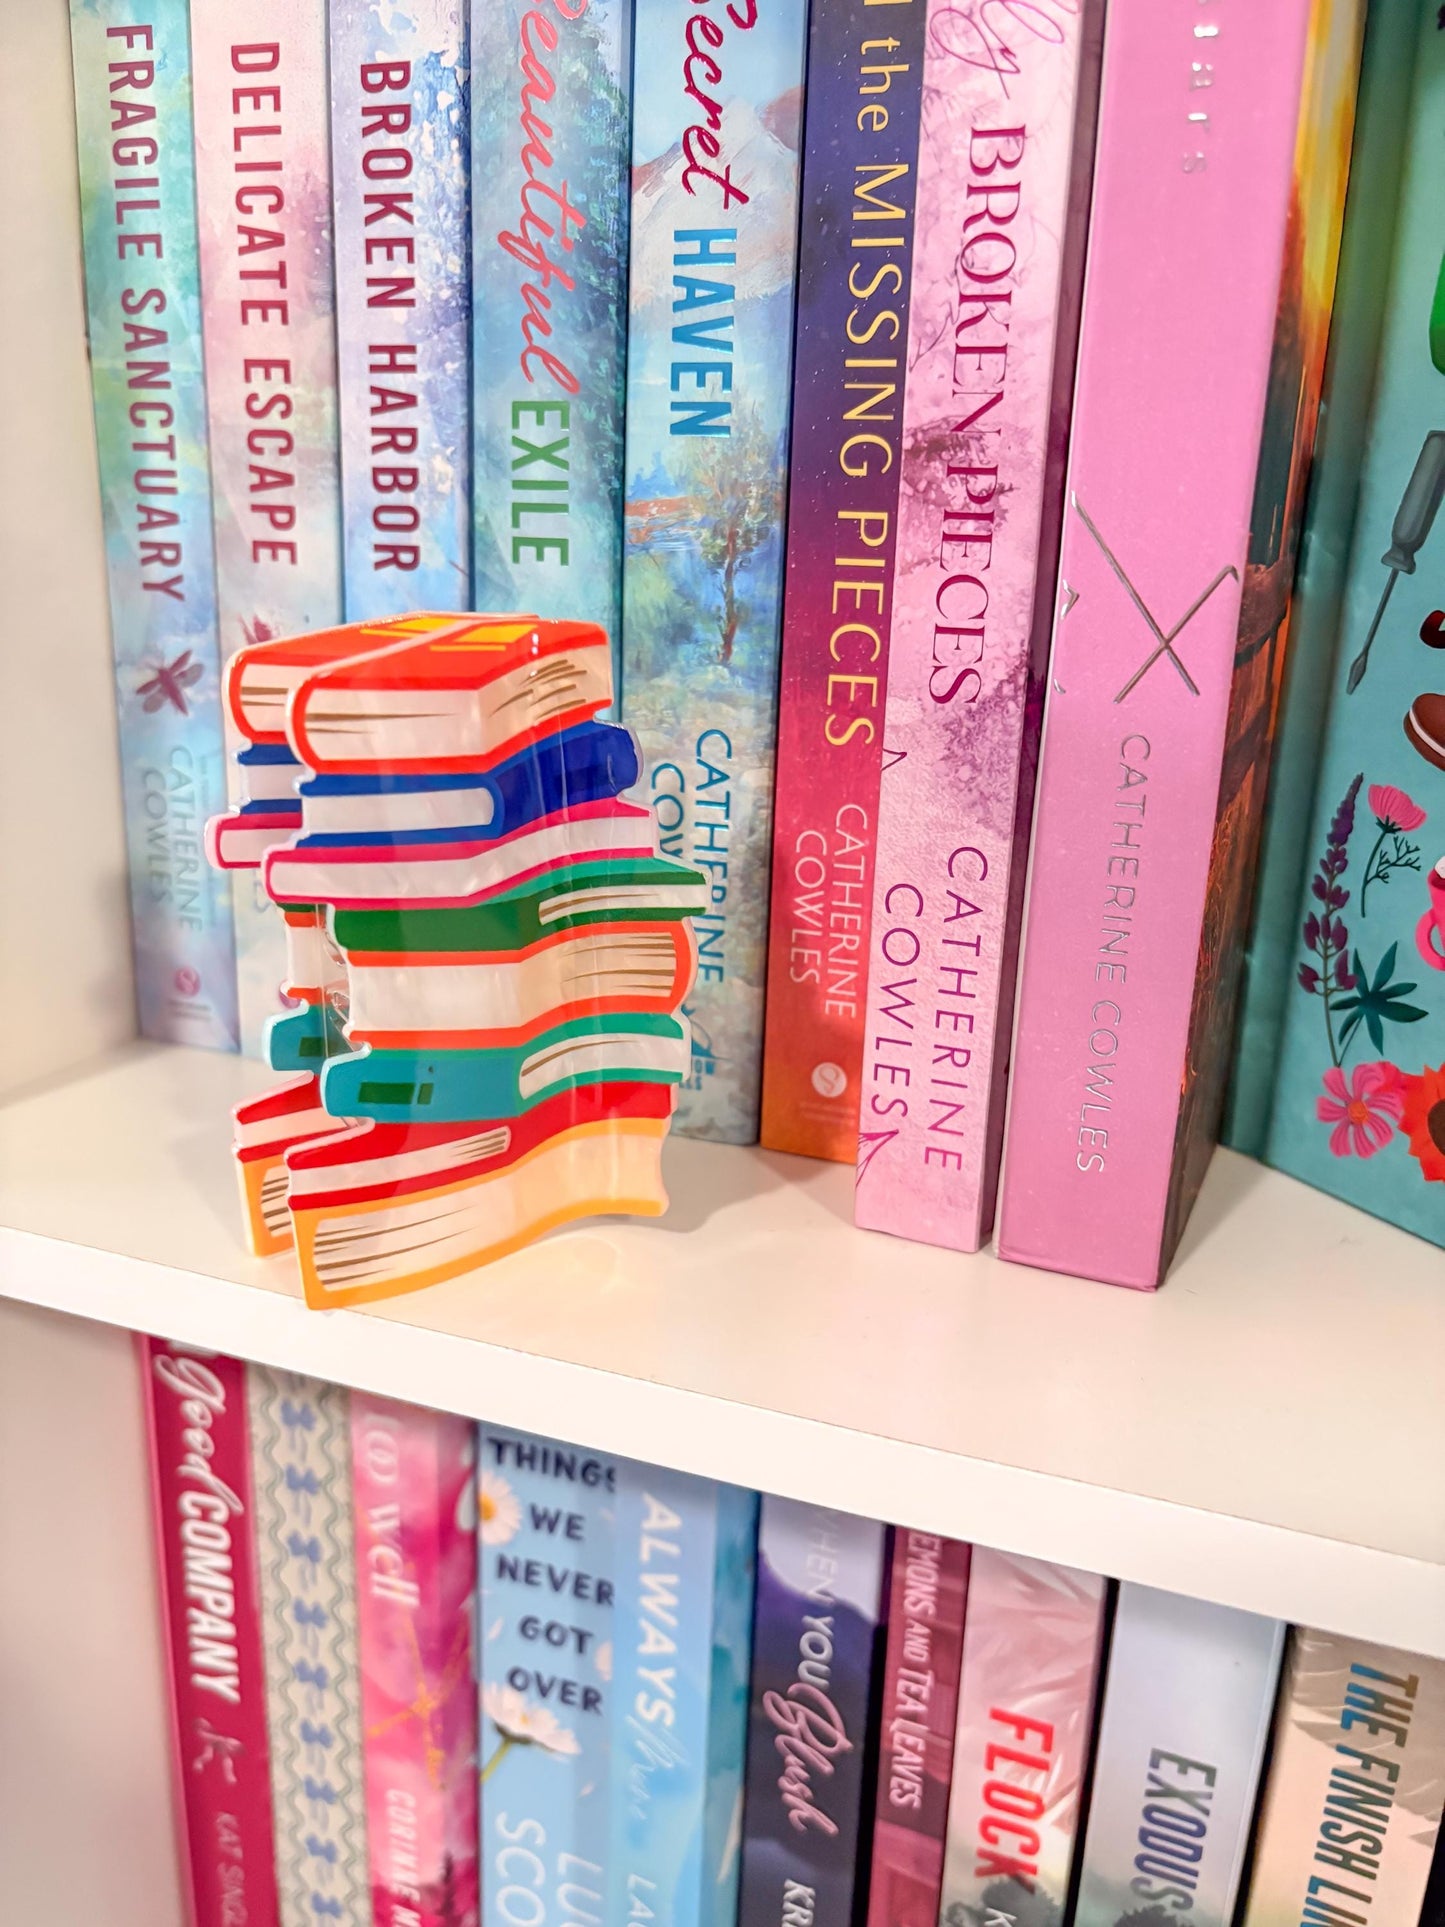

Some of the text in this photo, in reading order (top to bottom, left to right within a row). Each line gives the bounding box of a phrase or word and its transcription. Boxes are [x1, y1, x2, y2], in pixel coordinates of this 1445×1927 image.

[856, 35, 910, 133] the
[107, 24, 185, 602] FRAGILE SANCTUARY
[230, 41, 298, 567] DELICATE ESCAPE
[360, 60, 422, 573] BROKEN HARBOR
[498, 0, 588, 567] eautiful EXILE
[669, 228, 738, 438] HAVEN
[838, 162, 910, 478] MISSING
[951, 123, 1029, 437] BROKEN
[825, 509, 889, 747] PIECES
[929, 463, 1003, 706] PIECES
[142, 768, 174, 906] COWLES
[167, 744, 203, 933] CATHERINE
[790, 829, 827, 986] COWLES
[824, 803, 868, 1019] CATHERINE
[871, 882, 925, 1118] COWLES
[924, 846, 989, 1172] CATHERINE
[1077, 734, 1152, 1174] CATHERINE COWLES
[178, 1489, 242, 1704] COMPANY
[497, 1552, 616, 1607] NEVER
[529, 1502, 585, 1541] WE
[634, 1491, 683, 1728] ALWAYS
[506, 1666, 604, 1716] OVER
[518, 1614, 595, 1655] GOT
[797, 1614, 835, 1689] YOU
[895, 1667, 935, 1723] TEA
[903, 1619, 933, 1664] AND
[1340, 1662, 1420, 1748] THE
[762, 1682, 854, 1836] Blush
[889, 1719, 930, 1811] LEAVES
[973, 1706, 1055, 1895] FLOCK
[1129, 1747, 1218, 1912] EXODUS
[1314, 1743, 1401, 1881] FINISH
